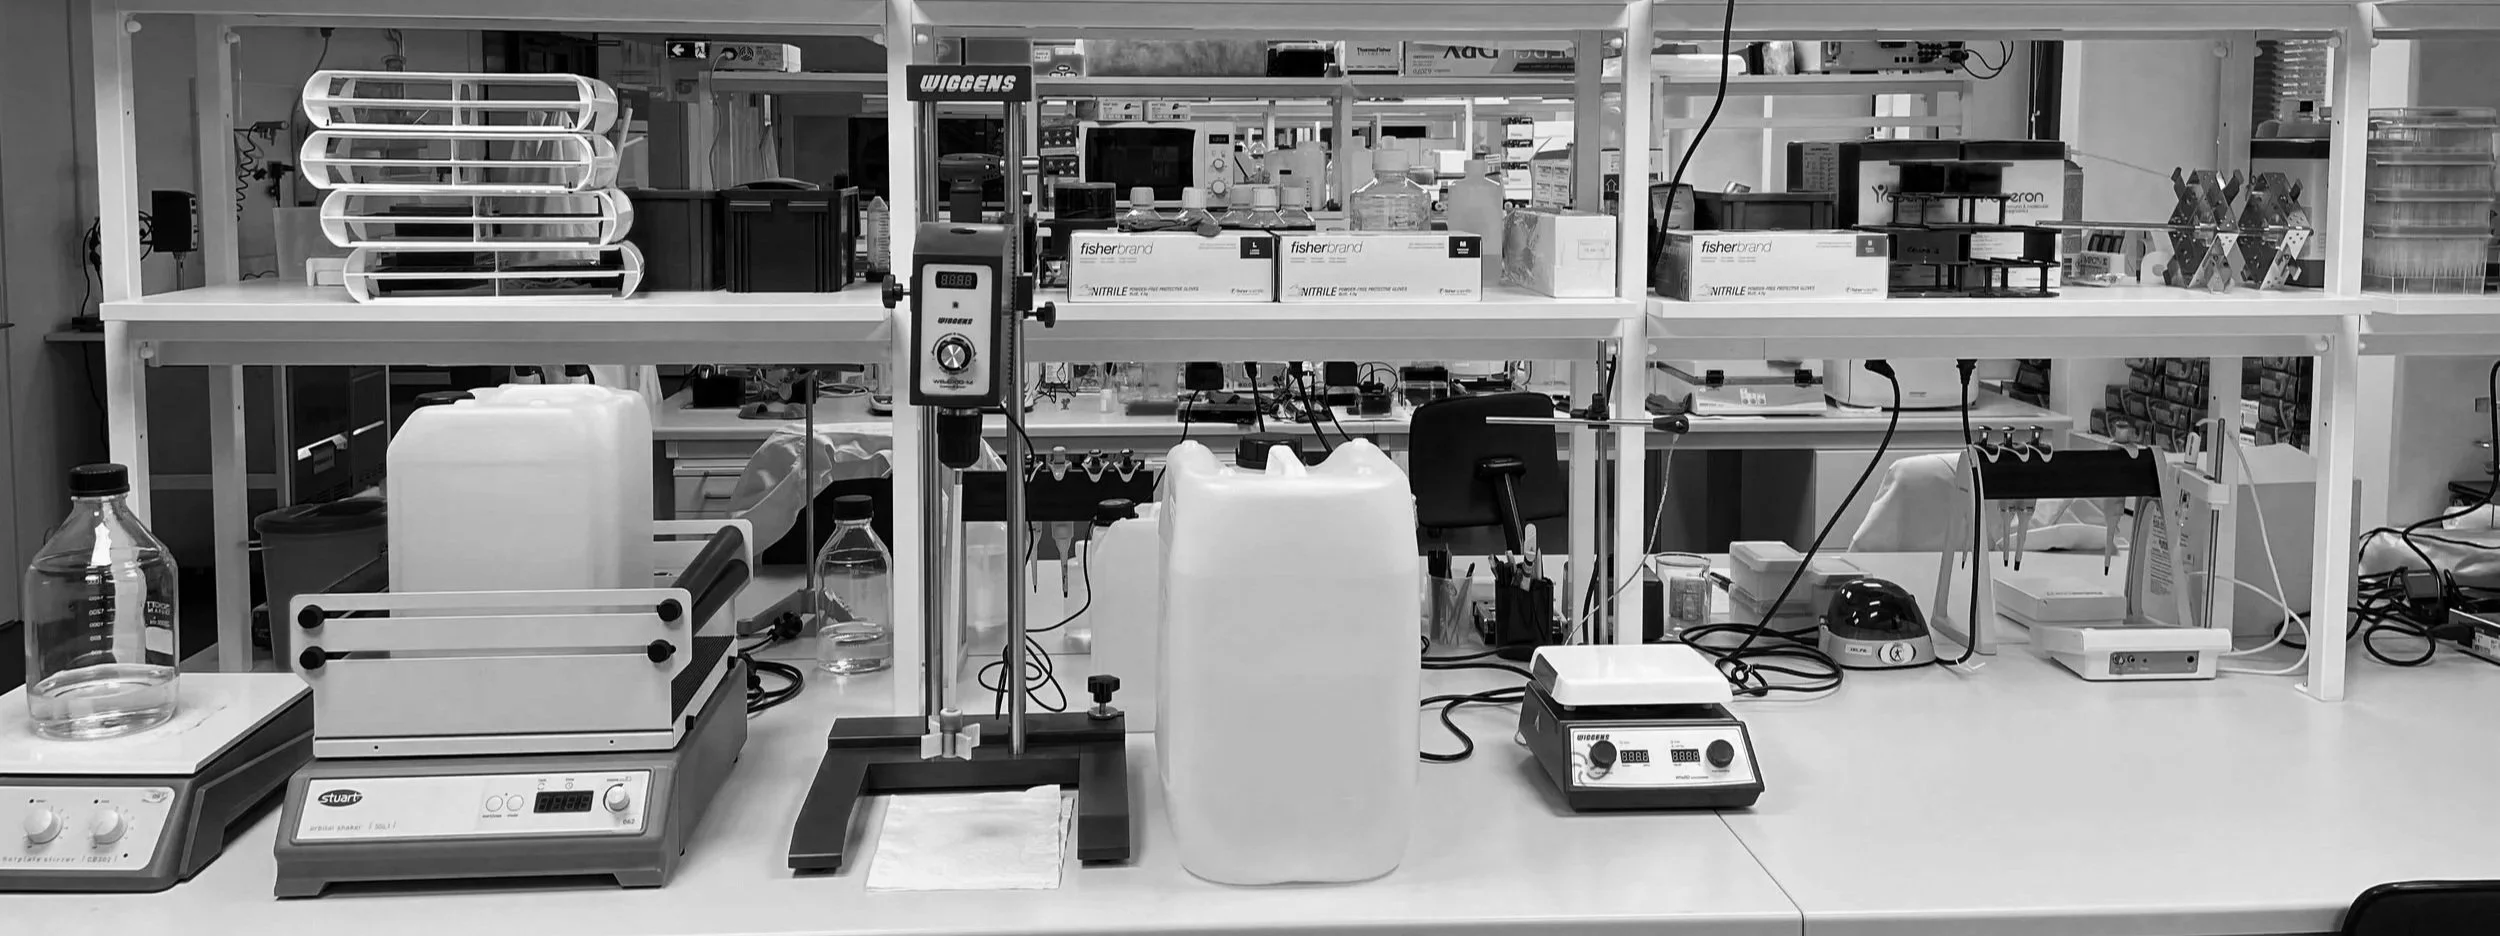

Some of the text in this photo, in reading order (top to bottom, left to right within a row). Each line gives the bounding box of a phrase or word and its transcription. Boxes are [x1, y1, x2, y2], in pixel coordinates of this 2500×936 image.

[920, 75, 1016, 92] WIGGENS
[1080, 242, 1154, 255] fisherbrand
[1290, 241, 1364, 254] fisherbrand
[1701, 240, 1773, 253] fisherbrand
[1092, 286, 1128, 296] NITRILE
[1302, 286, 1337, 296] NITRILE
[1711, 285, 1747, 296] NITRILE
[1576, 734, 1610, 742] WIGGENS
[320, 792, 362, 804] stuart
